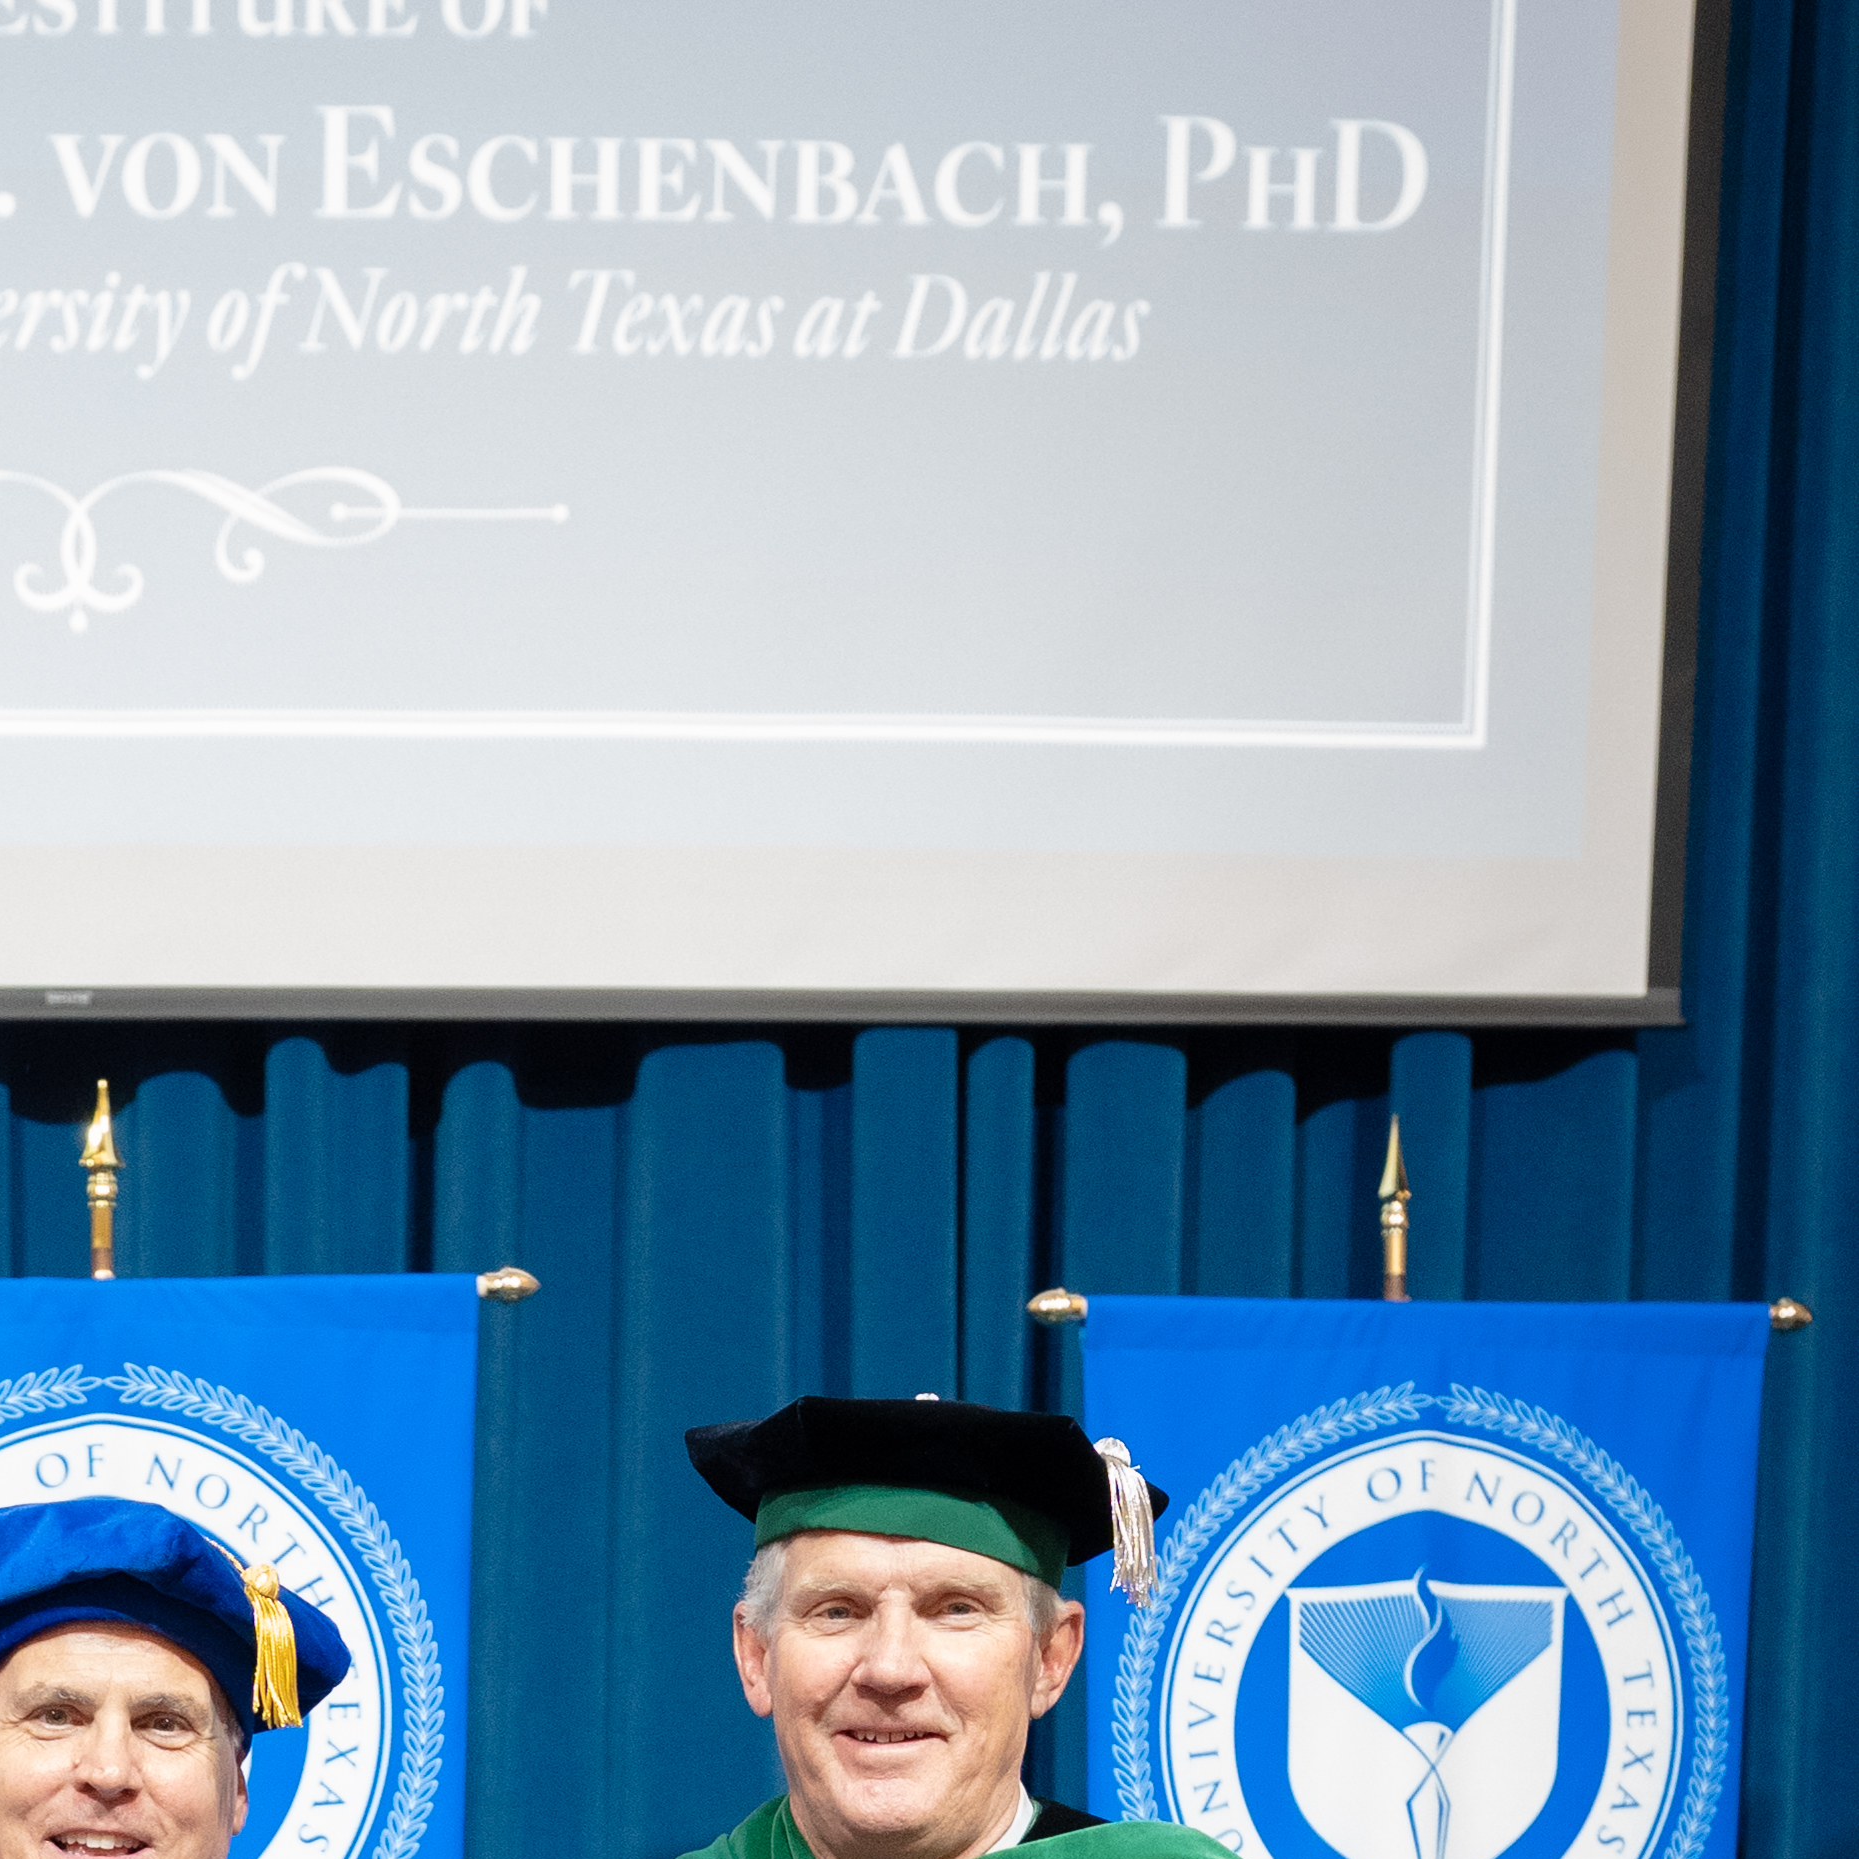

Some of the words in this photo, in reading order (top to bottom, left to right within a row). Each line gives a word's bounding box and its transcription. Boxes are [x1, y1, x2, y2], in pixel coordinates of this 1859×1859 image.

[205, 261, 310, 383] of
[299, 262, 543, 357] North
[567, 268, 786, 360] Texas
[791, 289, 884, 361] at
[889, 270, 1151, 363] Dallas
[35, 1443, 106, 1488] OF
[145, 1454, 335, 1611] NORTH
[1367, 1459, 1436, 1502] OF
[1465, 1470, 1635, 1628] NORTH
[1597, 1660, 1657, 1854] TEXAS
